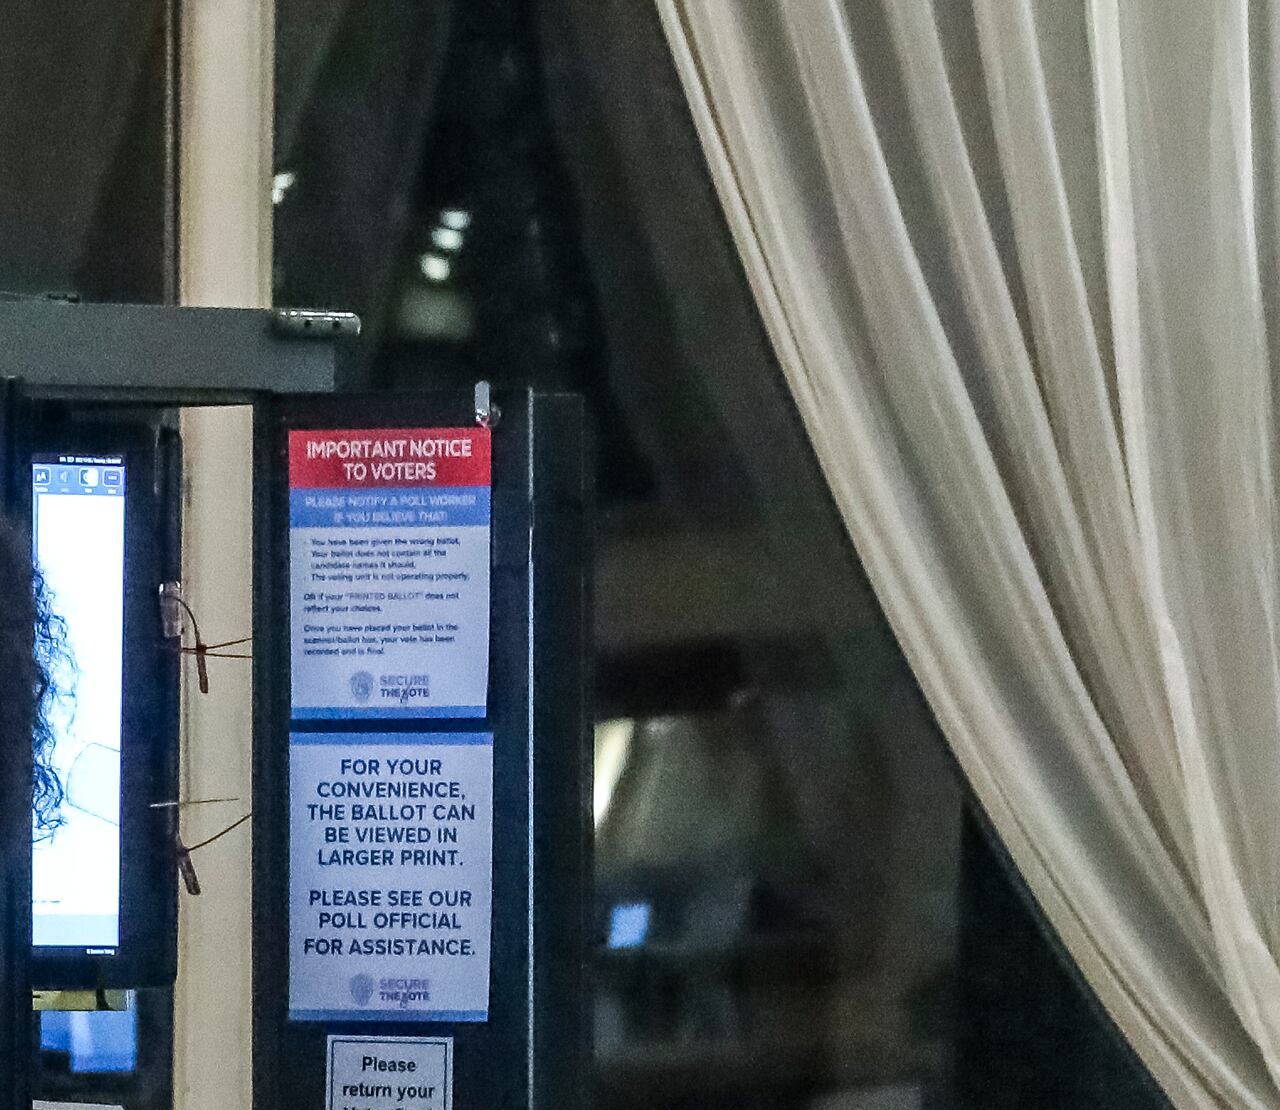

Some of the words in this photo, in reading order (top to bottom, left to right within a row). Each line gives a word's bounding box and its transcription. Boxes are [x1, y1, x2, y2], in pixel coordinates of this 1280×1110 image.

[307, 440, 407, 459] IMPORTANT
[410, 439, 472, 457] NOTICE
[344, 462, 367, 480] TO
[371, 462, 436, 480] VOTERS
[305, 496, 345, 507] PLEASE
[348, 496, 387, 506] NOTIFY
[390, 495, 398, 507] A
[401, 495, 427, 507] POLL
[430, 495, 476, 505] WORKER
[347, 511, 369, 522] YOU
[371, 538, 392, 546] given
[395, 538, 407, 546] the
[409, 538, 434, 546] wrong
[377, 550, 389, 558] not
[381, 573, 393, 582] not
[380, 675, 430, 686] SECURE
[340, 759, 380, 775] FOR
[387, 759, 442, 775] YOUR
[317, 782, 466, 800] CONVENIENCE,
[307, 804, 345, 821] THE
[351, 804, 425, 821] BALLOT
[433, 804, 475, 821] CAN
[324, 827, 349, 843] BE
[355, 827, 431, 843] VIEWED
[438, 827, 457, 843] IN
[318, 850, 394, 866] LARGER
[400, 850, 464, 866] PRINT.
[309, 890, 381, 906] PLEASE
[387, 890, 423, 906] SEE
[429, 890, 472, 906] OUR
[319, 913, 367, 929] POLL
[374, 913, 461, 929] OFFICIAL
[304, 939, 343, 956] FOR
[348, 939, 476, 956] ASSISTANCE.
[379, 979, 430, 991] SECURE
[362, 1056, 416, 1072] Please
[342, 1084, 391, 1097] return
[397, 1087, 435, 1101] your
